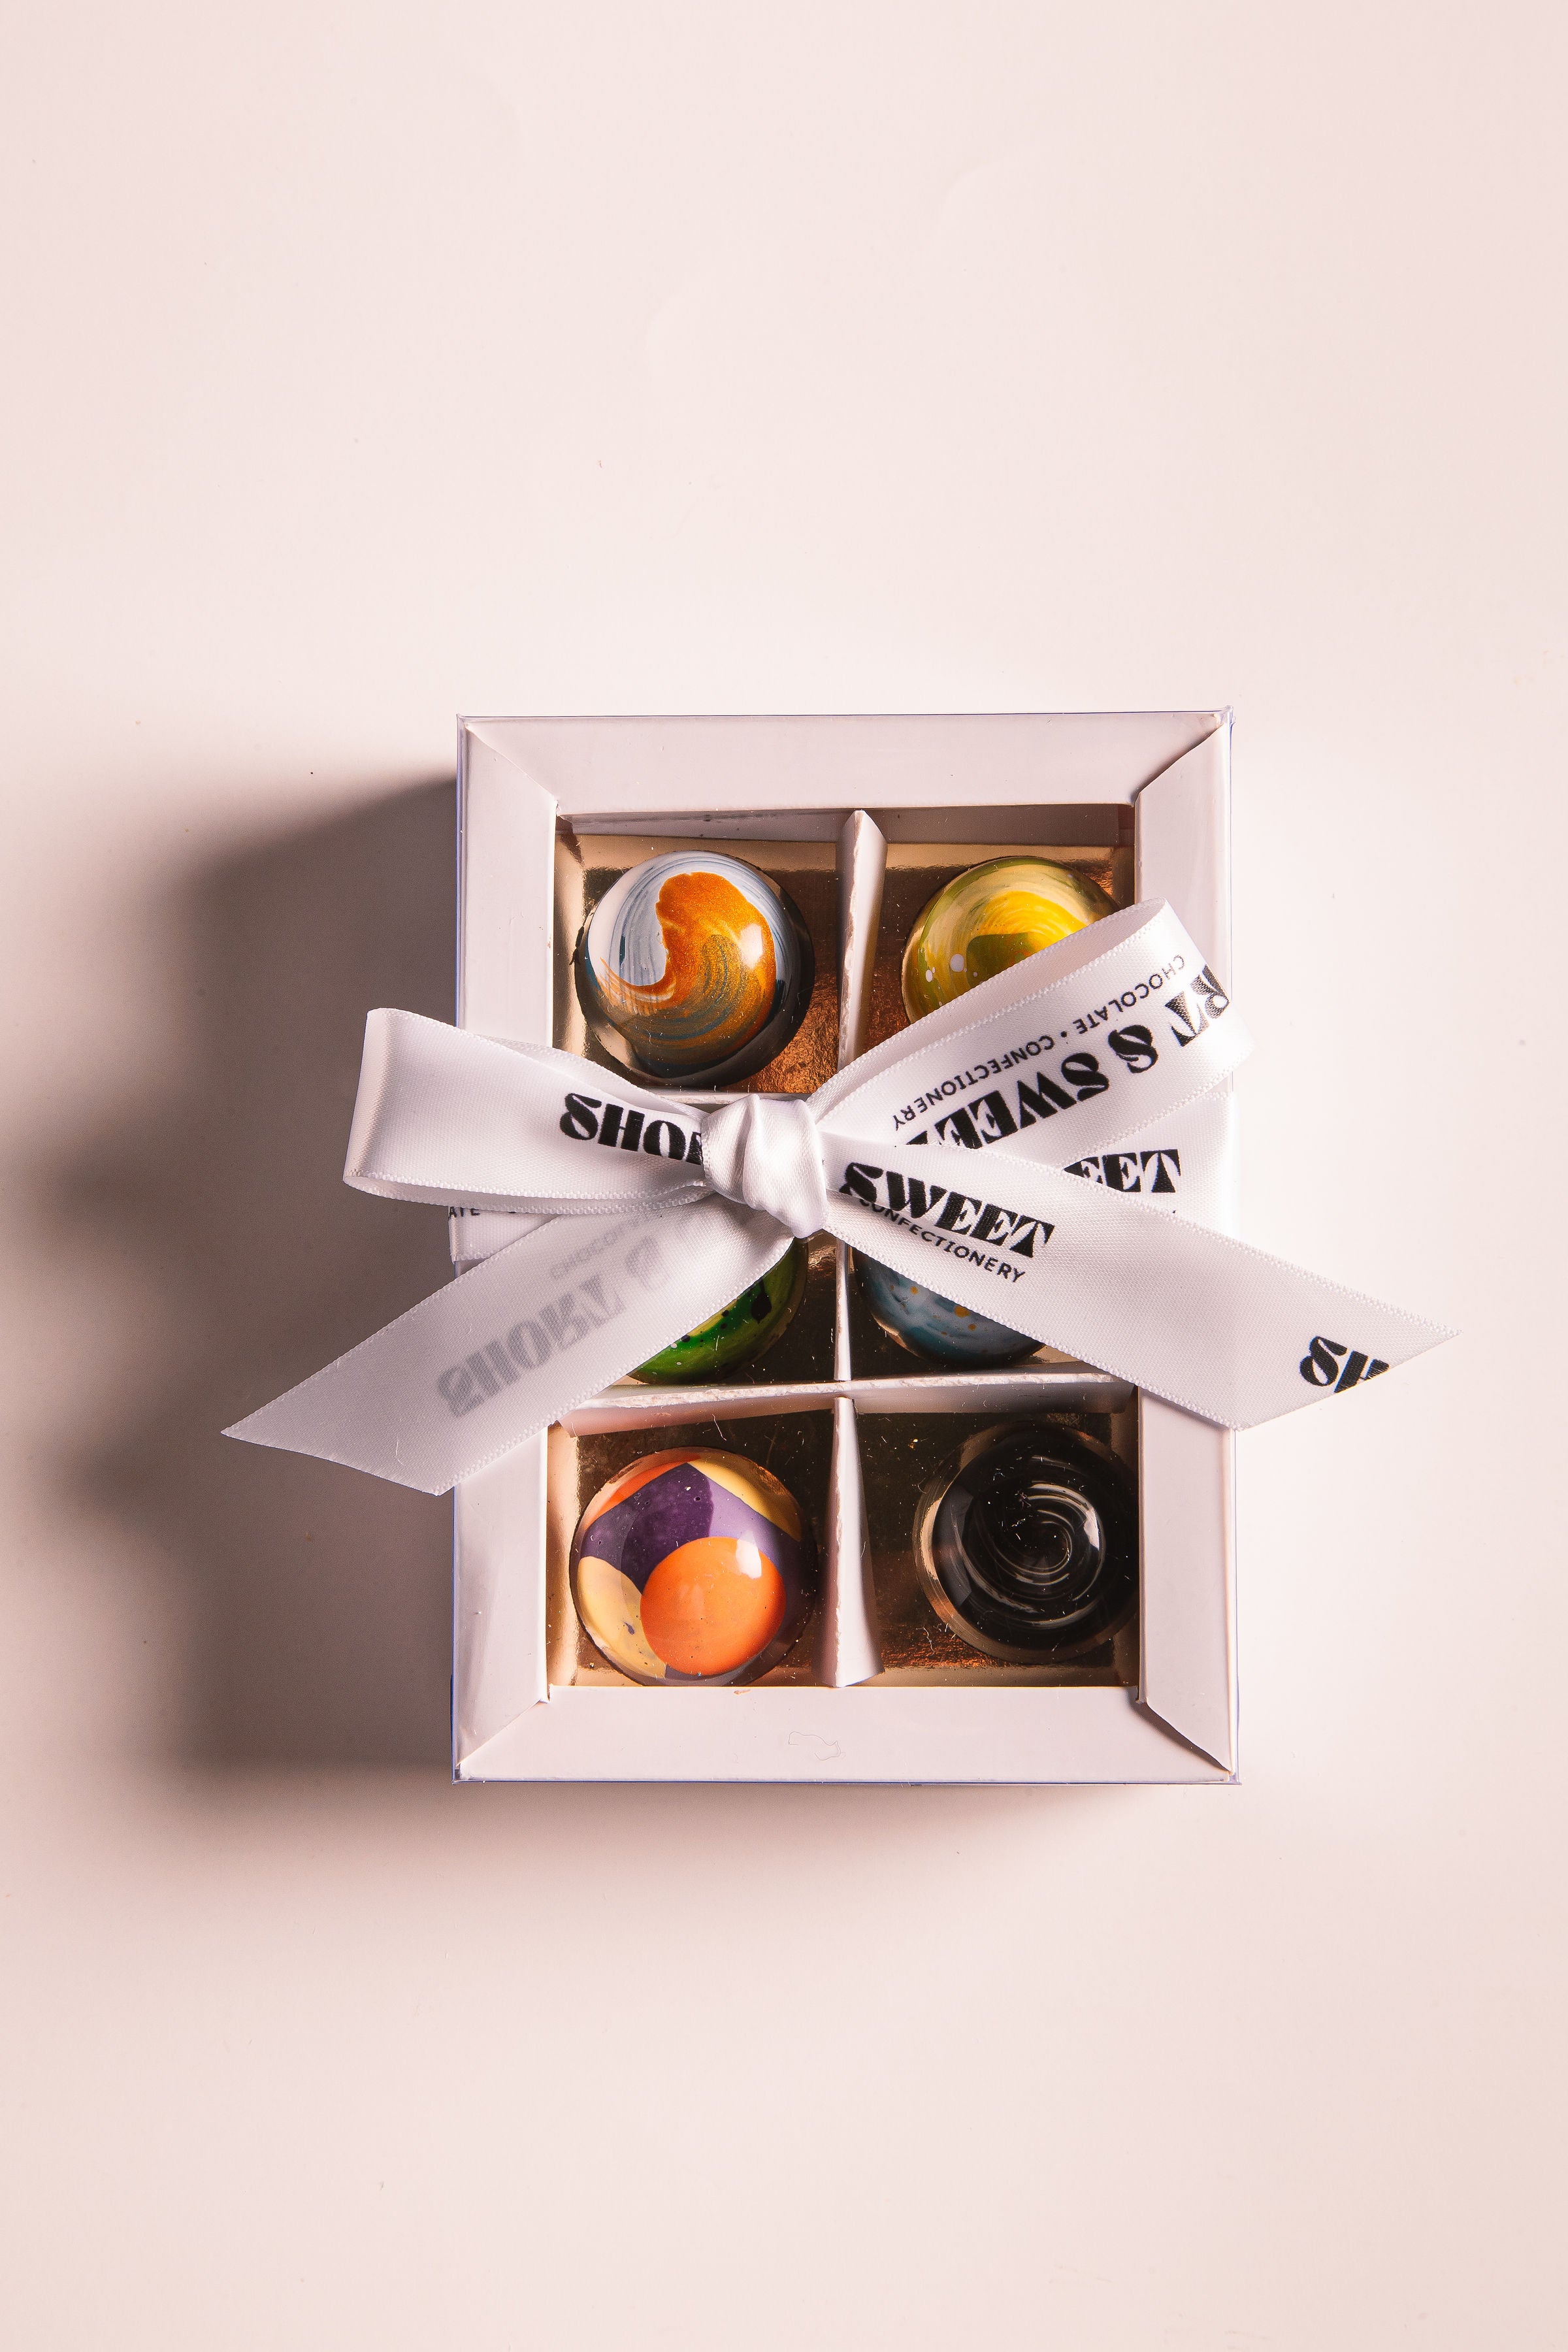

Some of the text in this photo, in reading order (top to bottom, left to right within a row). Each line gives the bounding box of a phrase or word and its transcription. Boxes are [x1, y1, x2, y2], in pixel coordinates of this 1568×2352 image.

[894, 955, 1184, 1131] CHOCOLATE CONFECTIONERY
[906, 1053, 1109, 1149] SWEE
[840, 1162, 1054, 1258] SWEET
